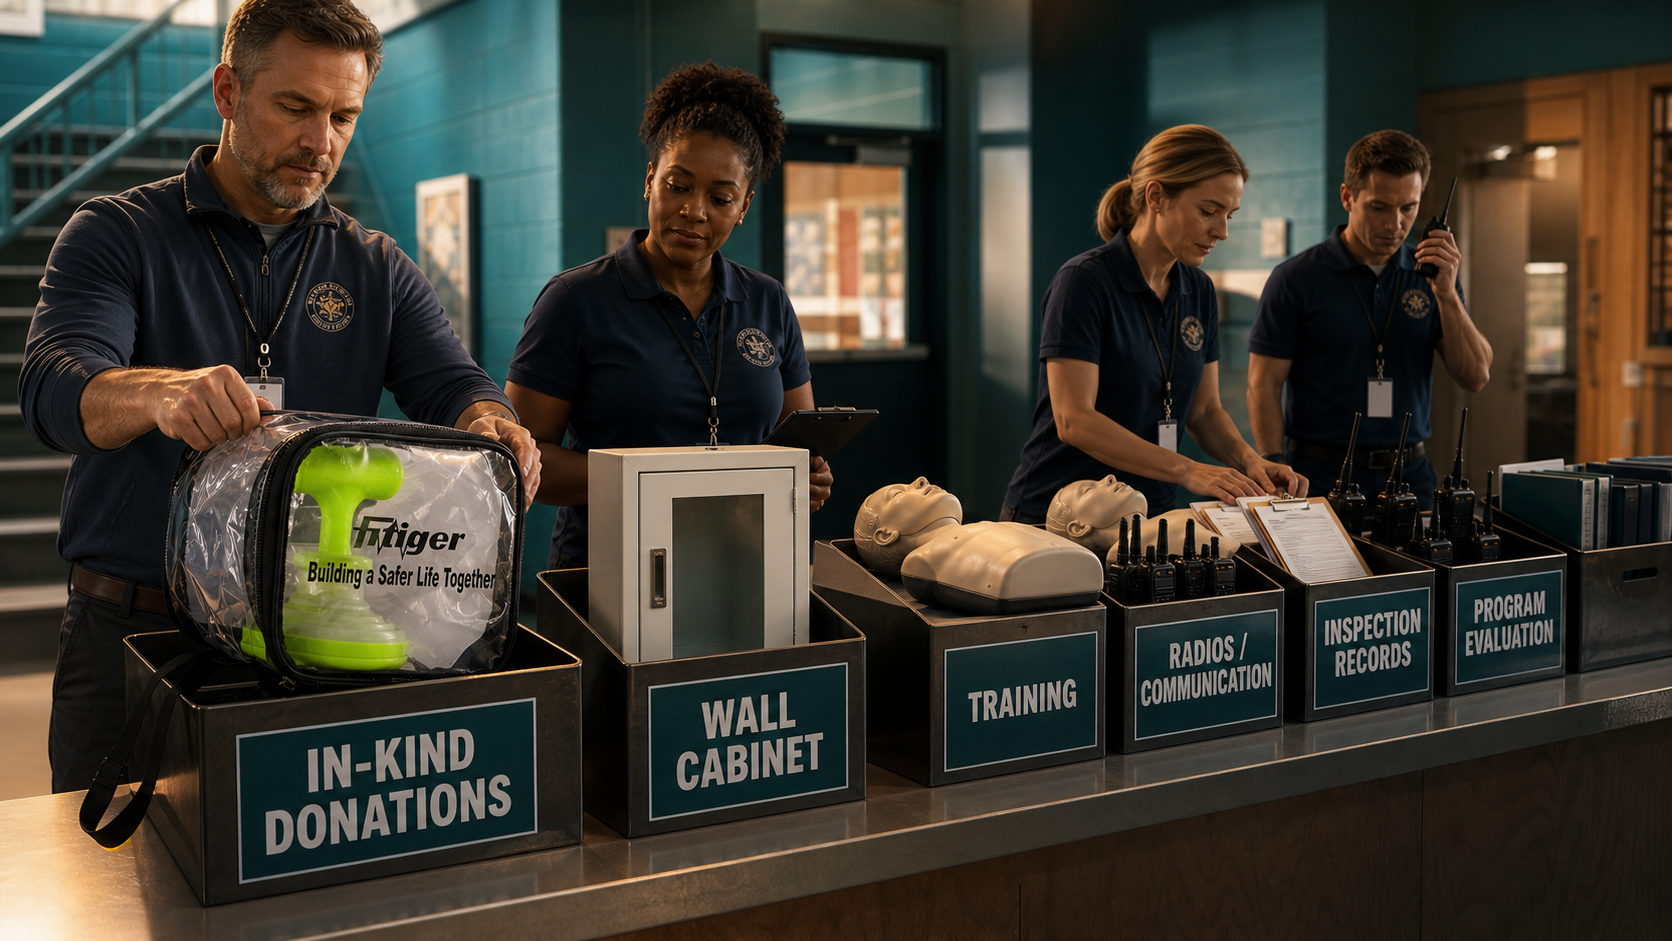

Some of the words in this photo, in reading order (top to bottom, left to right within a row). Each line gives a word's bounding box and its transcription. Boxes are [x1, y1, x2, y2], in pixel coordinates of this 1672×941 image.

[307, 561, 363, 590] Building
[366, 569, 374, 585] a
[378, 564, 413, 587] Safer
[417, 566, 439, 587] Life
[444, 567, 496, 593] Together
[1324, 608, 1421, 646] INSPECTION
[1474, 591, 1546, 624] PROGRAM
[1169, 636, 1235, 670] RADIOS
[1239, 632, 1248, 661] /
[1465, 619, 1554, 657] EVALUATION
[1335, 641, 1412, 678] RECORDS
[968, 678, 1077, 723] TRAINING
[1140, 661, 1272, 708] COMMUNICATION
[701, 691, 796, 740] WALL
[307, 728, 475, 793] IN-KIND
[676, 732, 824, 791] CABINET
[265, 774, 512, 856] DONATIONS
